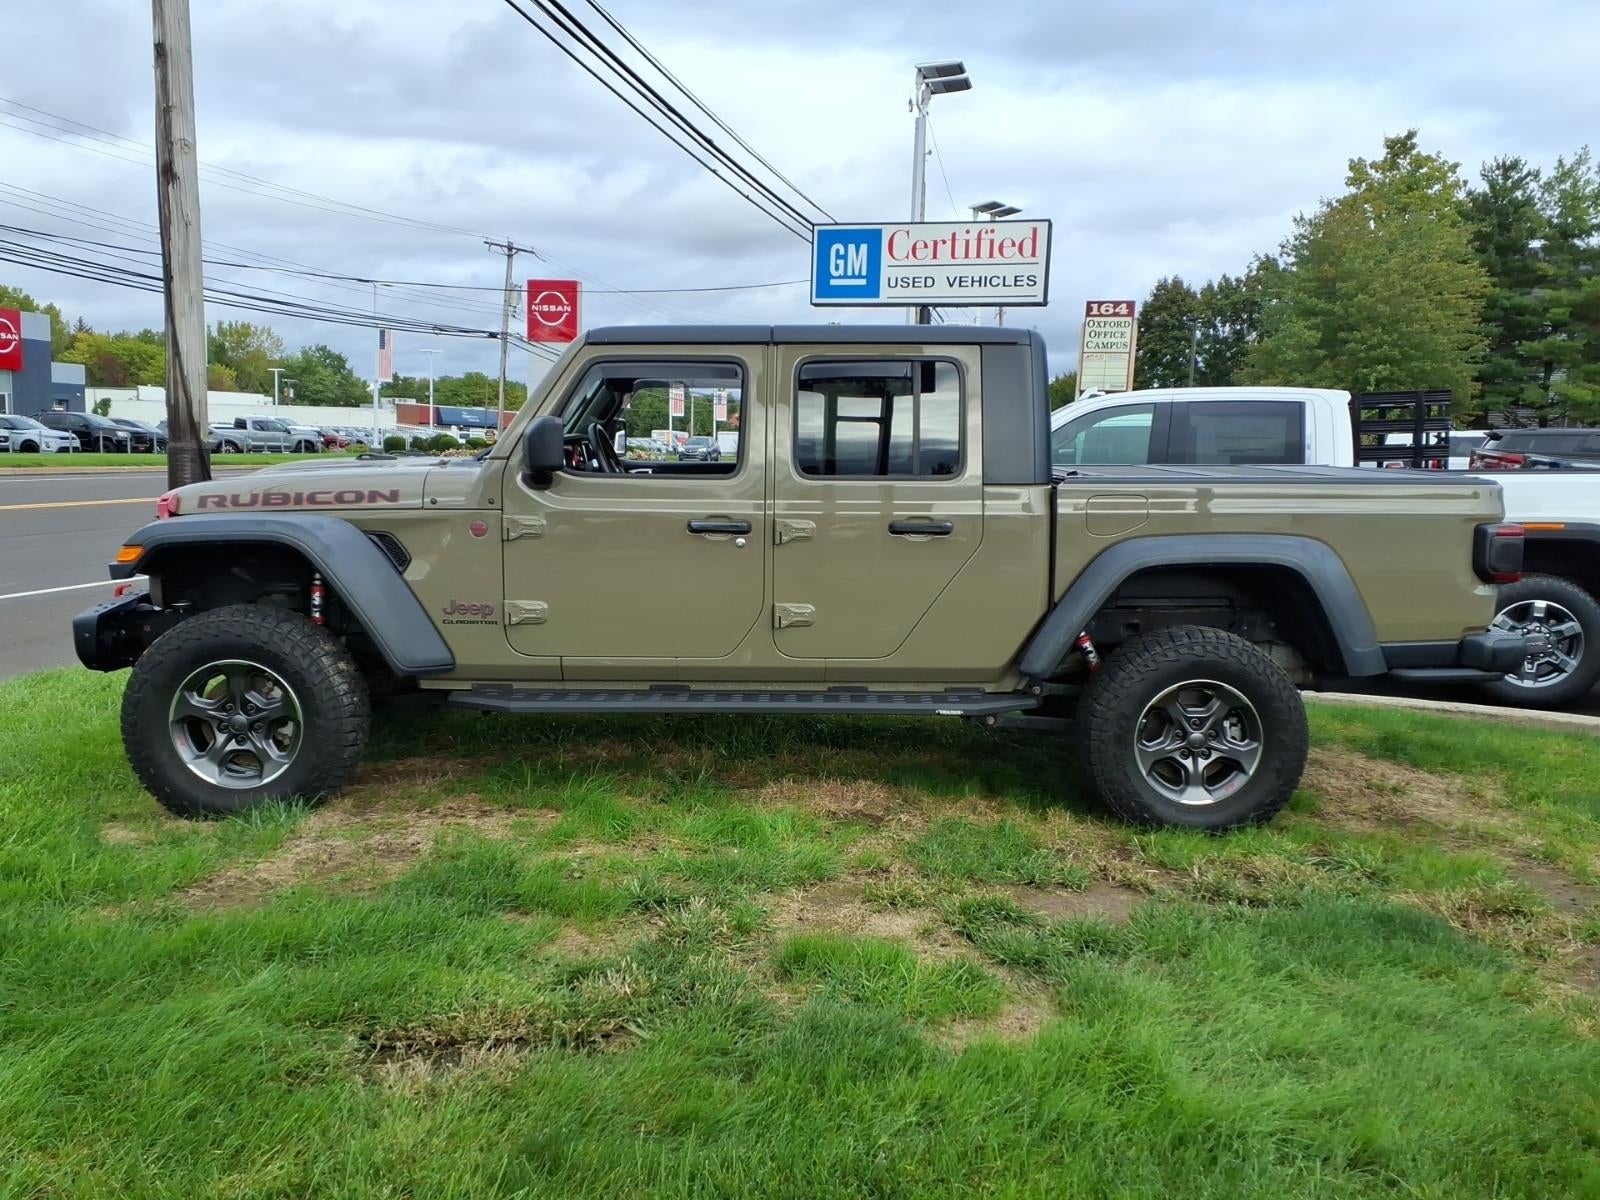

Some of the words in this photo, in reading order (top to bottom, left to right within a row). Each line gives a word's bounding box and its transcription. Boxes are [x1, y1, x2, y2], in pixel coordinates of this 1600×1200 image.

[887, 227, 1039, 261] Certified
[829, 243, 868, 277] GM
[887, 276, 935, 288] USED
[946, 275, 1038, 288] VEHICLES
[531, 304, 571, 312] NISSAN
[1089, 303, 1129, 315] 164
[197, 489, 400, 508] RUBICON
[442, 599, 495, 619] Jeep
